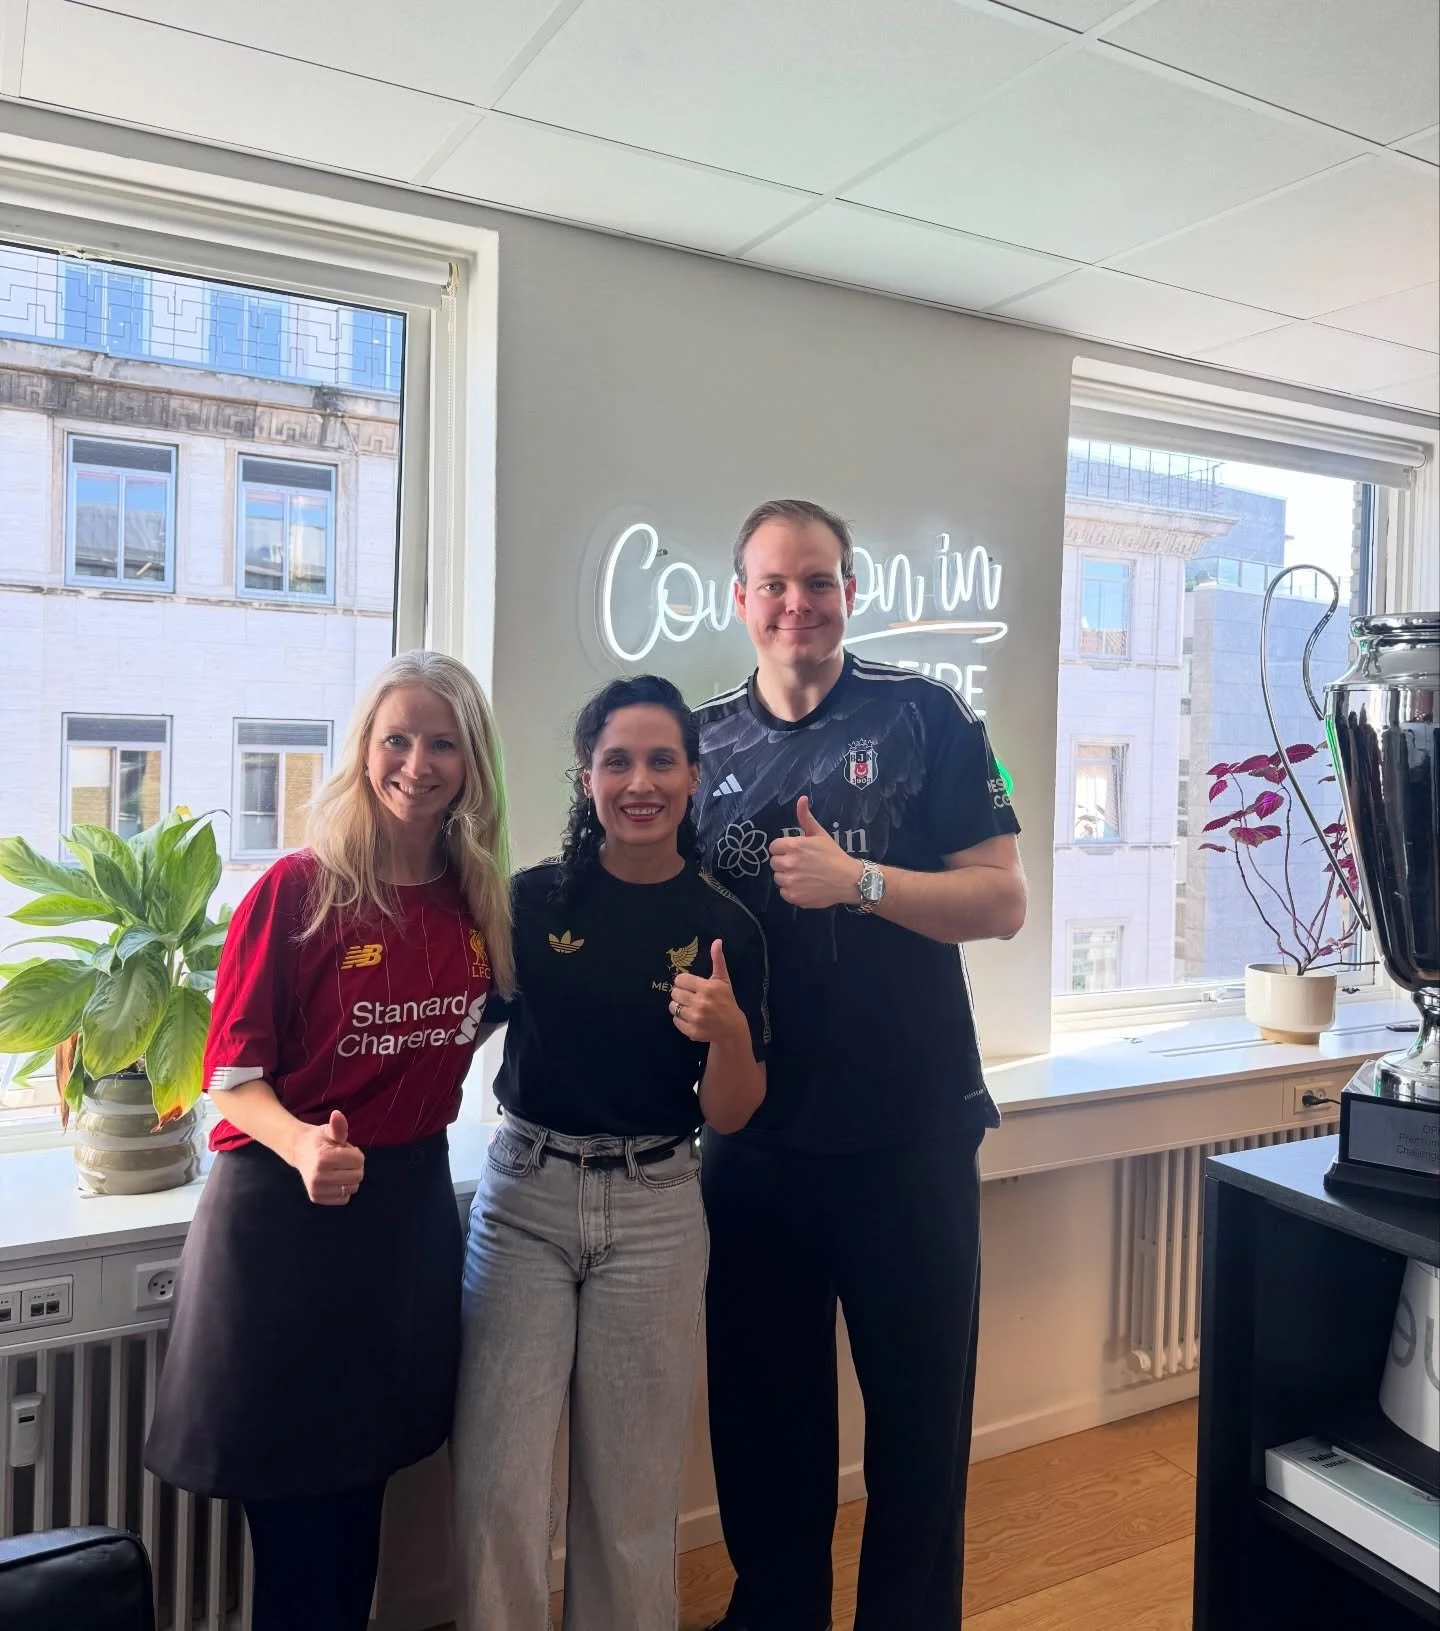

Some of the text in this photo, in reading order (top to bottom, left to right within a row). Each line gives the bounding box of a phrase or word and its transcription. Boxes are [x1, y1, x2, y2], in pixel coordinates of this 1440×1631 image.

[602, 523, 738, 661] Co
[936, 533, 1002, 611] in
[472, 966, 491, 979] LFC
